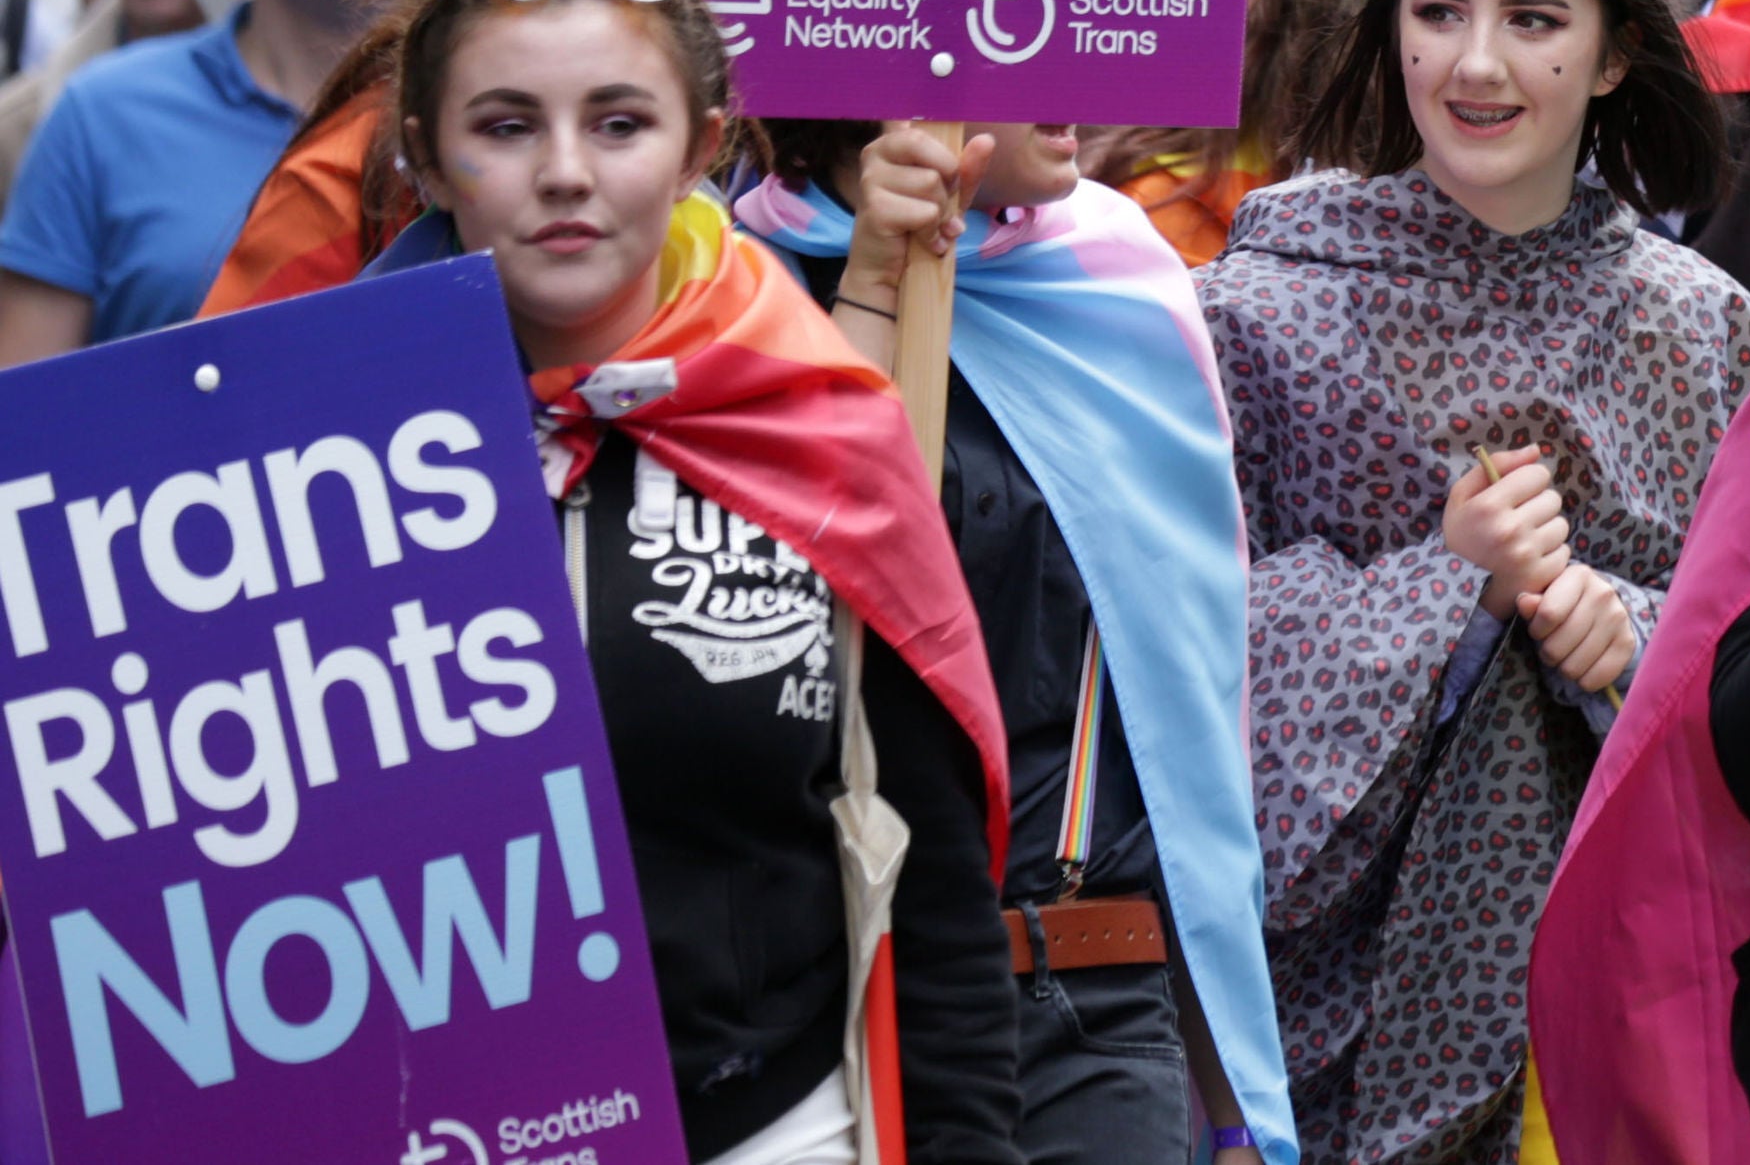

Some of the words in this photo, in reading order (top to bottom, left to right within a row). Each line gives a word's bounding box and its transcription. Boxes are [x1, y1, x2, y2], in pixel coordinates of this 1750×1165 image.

[784, 15, 932, 50] Network
[1068, 22, 1157, 55] Trans
[0, 410, 498, 657] Trans
[3, 599, 557, 867] Rights
[49, 765, 621, 1118] Now!
[497, 1087, 641, 1154] Scottish
